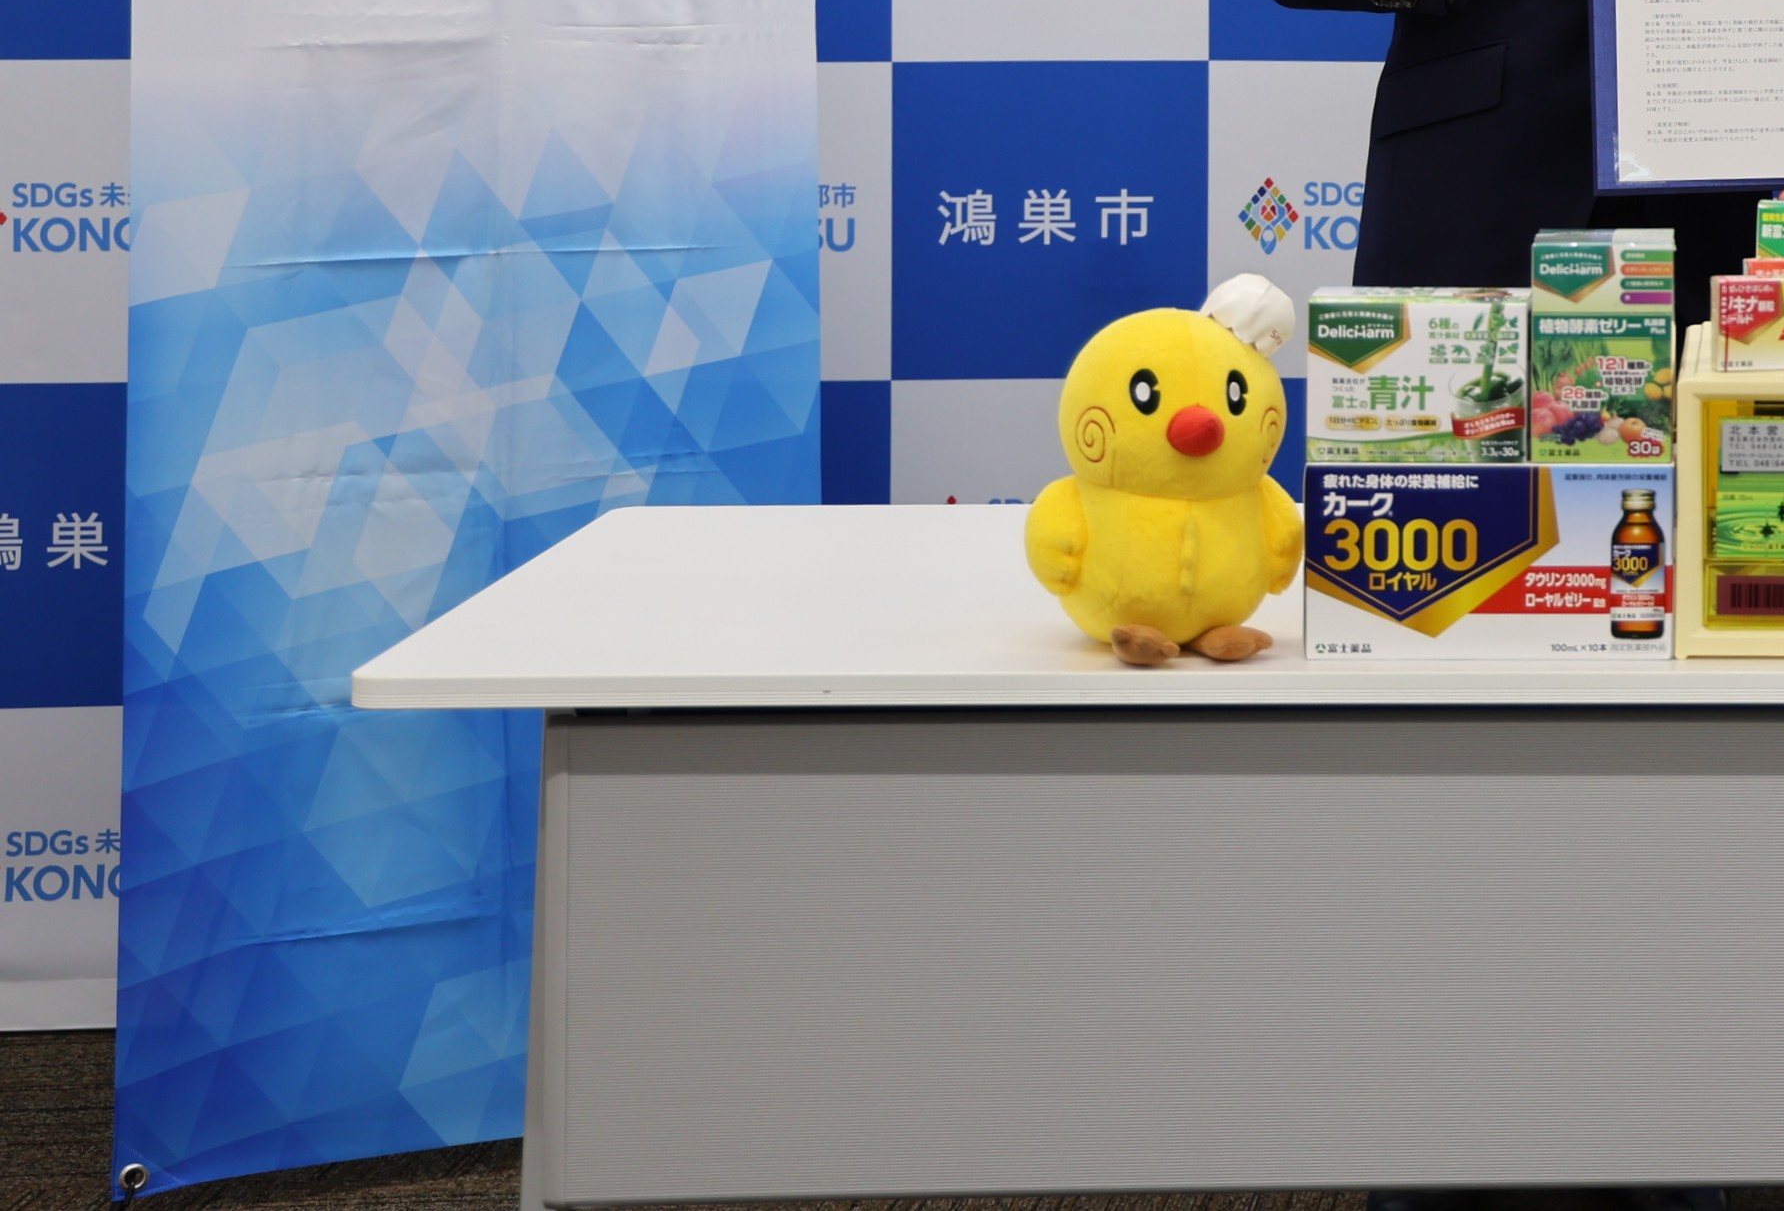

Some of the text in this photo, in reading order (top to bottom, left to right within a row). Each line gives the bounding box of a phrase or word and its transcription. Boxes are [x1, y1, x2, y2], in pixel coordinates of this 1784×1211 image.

[13, 183, 93, 208] SDGs
[939, 189, 1153, 245] 鴻巣市
[1539, 318, 1642, 335] 植物酵素ゼリー
[1367, 375, 1434, 410] 青汁
[1323, 474, 1479, 489] 疲れた身体の栄養補給に
[1323, 492, 1394, 516] カーク
[1323, 519, 1478, 571] 3000
[1613, 557, 1648, 571] 3000
[1369, 572, 1437, 590] ロイヤル
[1525, 573, 1606, 589] タウリン3000mg
[1525, 593, 1591, 608] ローヤルゼリー
[6, 830, 89, 857] SDGs
